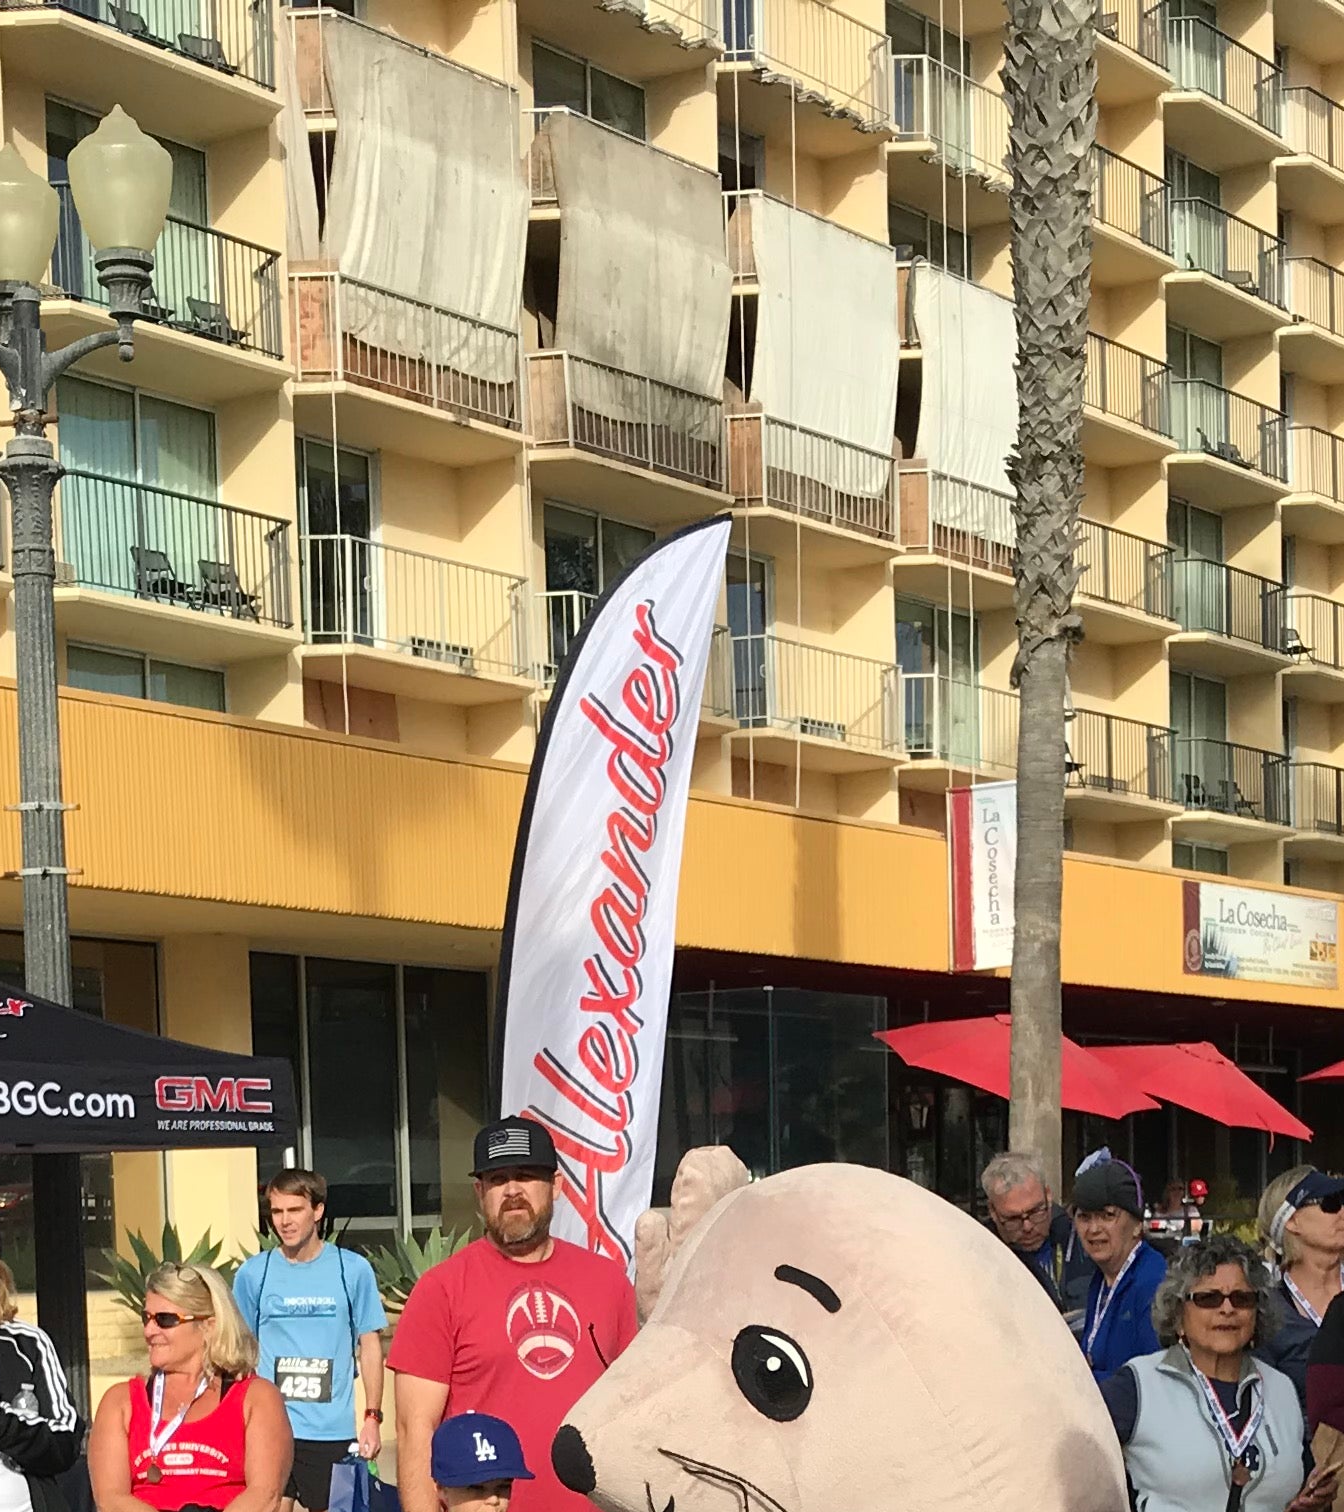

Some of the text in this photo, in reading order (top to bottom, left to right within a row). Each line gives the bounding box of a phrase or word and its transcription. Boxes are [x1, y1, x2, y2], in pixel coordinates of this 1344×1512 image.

[982, 808, 1001, 825] La
[984, 827, 1001, 926] Cosecha
[1219, 898, 1236, 925] La
[1237, 901, 1288, 932] Cosecha
[524, 598, 684, 1272] Alexander
[154, 1075, 273, 1114] GMC
[157, 1119, 275, 1132] WE ARE PROFESSIONAL GRADE
[278, 1357, 329, 1368] Mile 26
[280, 1375, 322, 1398] 425
[178, 1442, 229, 1464] UNIVERSITY
[472, 1432, 497, 1462] LA
